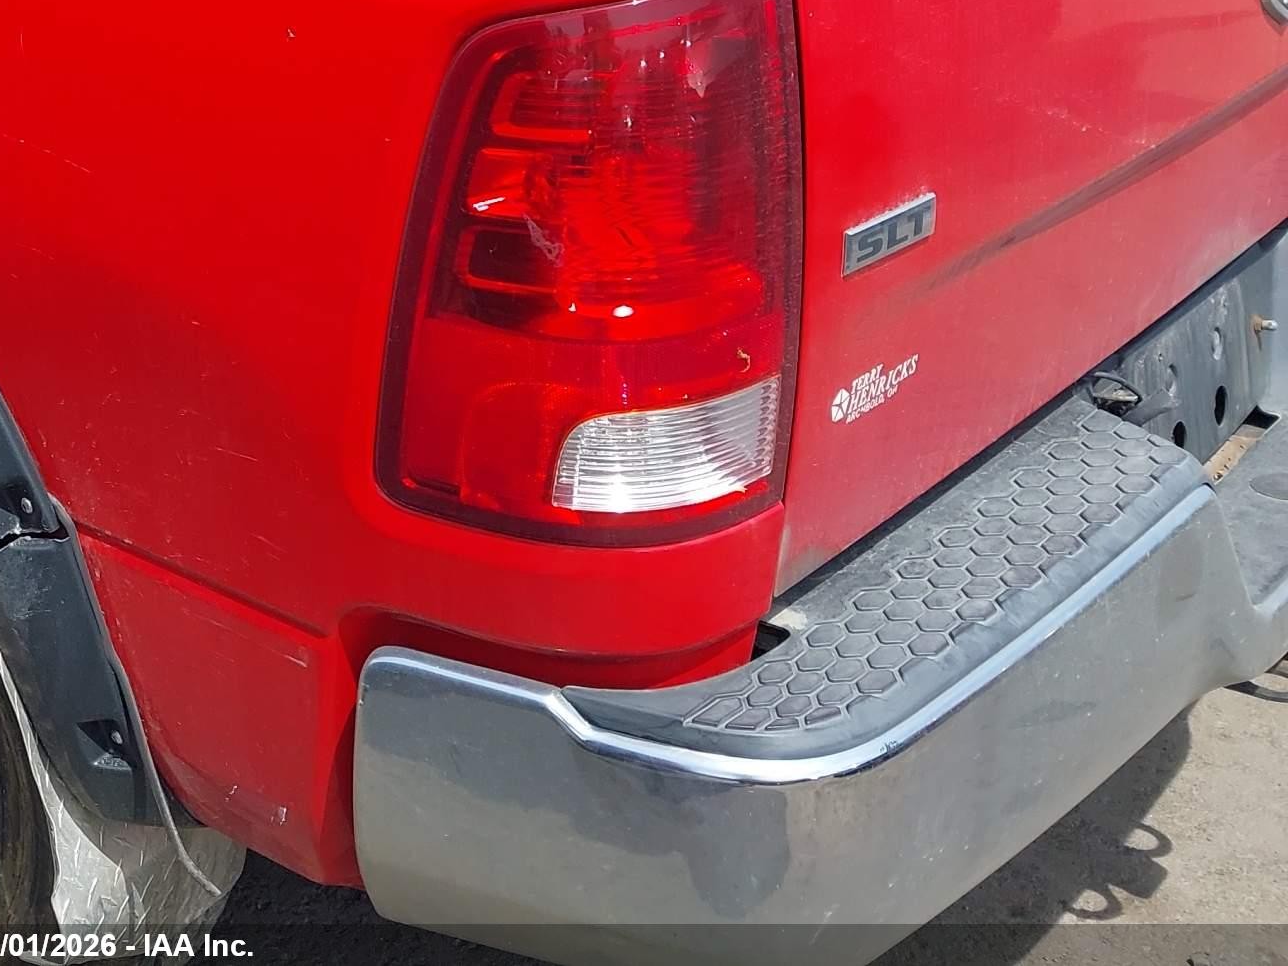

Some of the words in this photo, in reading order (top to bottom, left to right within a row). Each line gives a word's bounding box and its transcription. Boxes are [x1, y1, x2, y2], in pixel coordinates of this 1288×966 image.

[856, 204, 932, 263] SLT
[847, 353, 919, 414] HENRICKS
[850, 363, 884, 394] TERRY
